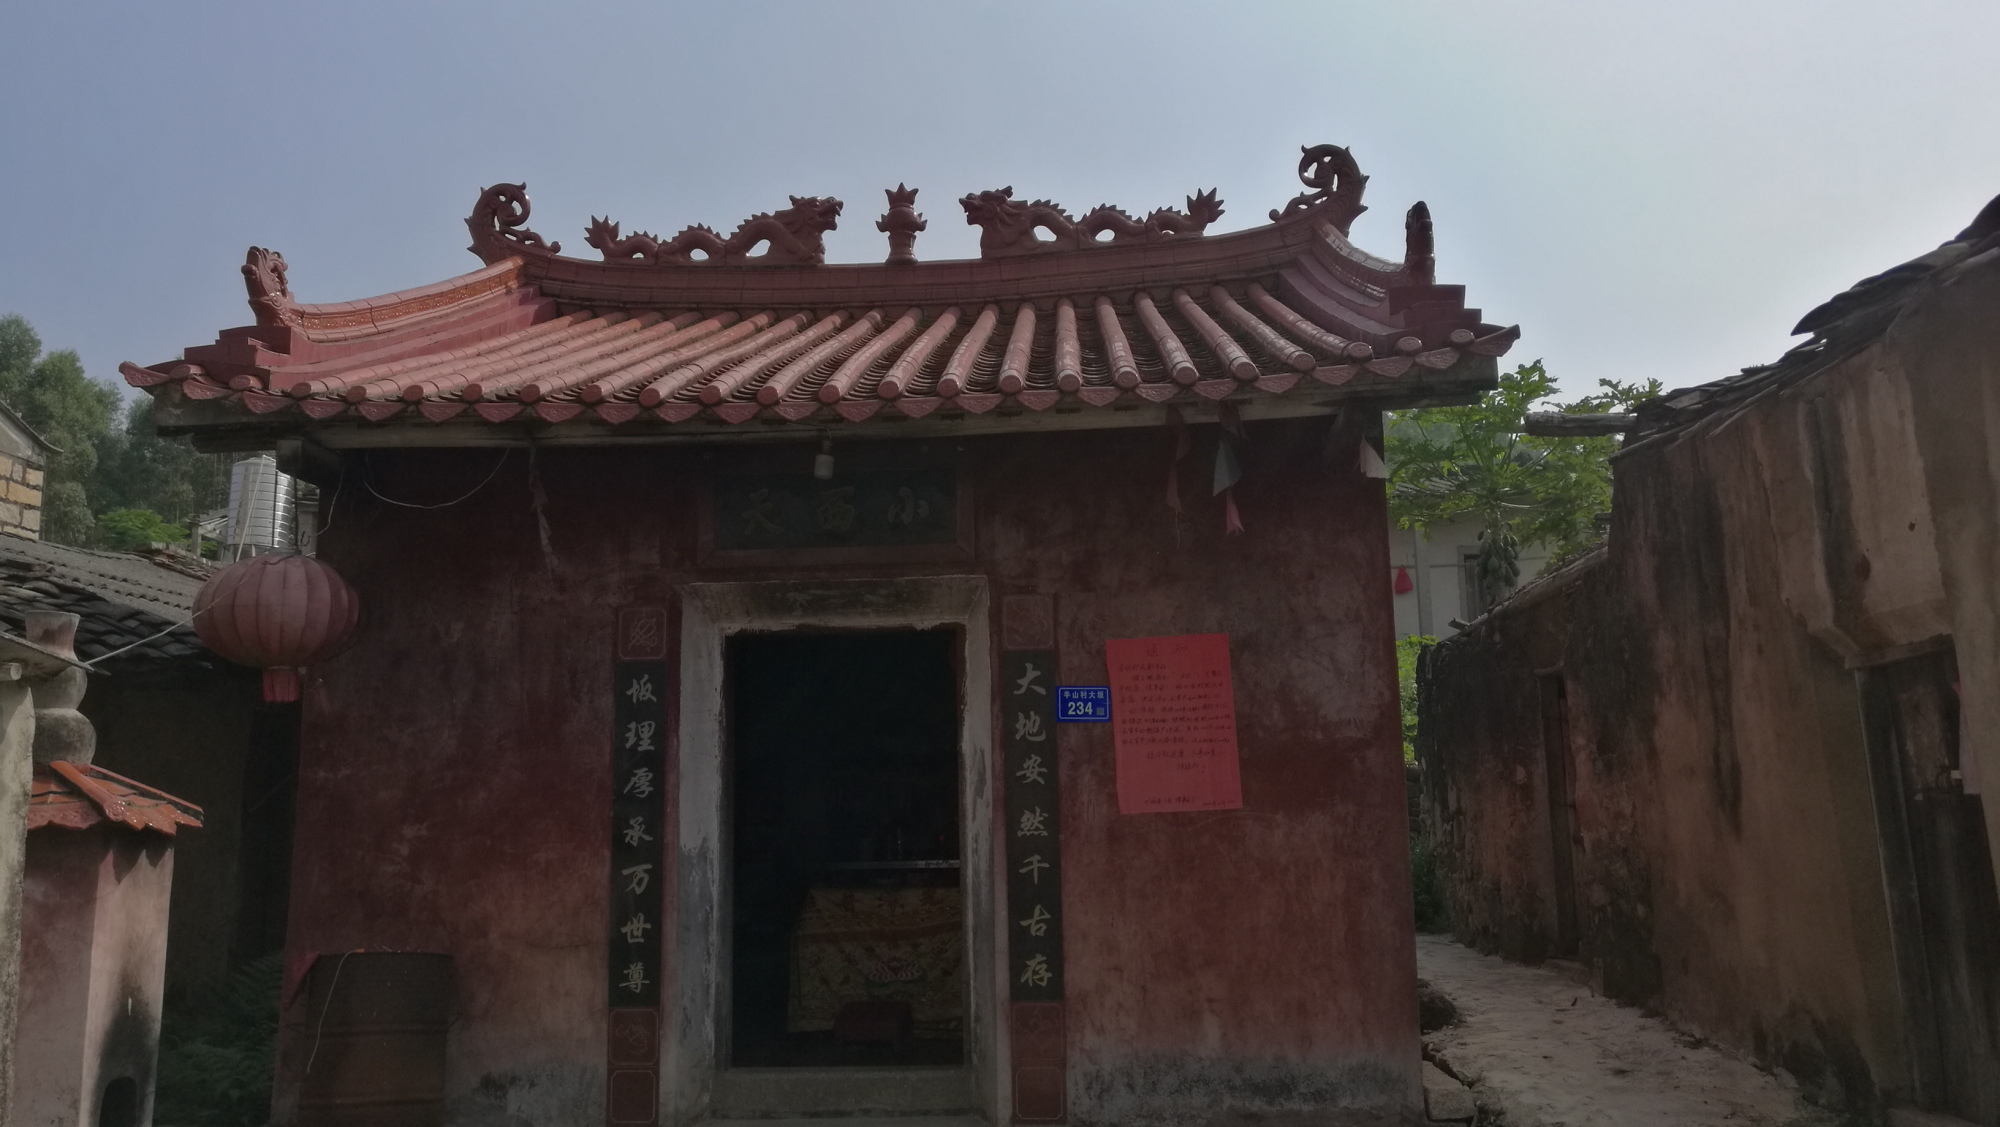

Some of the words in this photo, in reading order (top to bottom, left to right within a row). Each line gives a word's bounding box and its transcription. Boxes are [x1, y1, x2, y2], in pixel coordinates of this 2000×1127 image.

[1068, 701, 1093, 715] 234
[1013, 662, 1052, 986] 大地安然千古存
